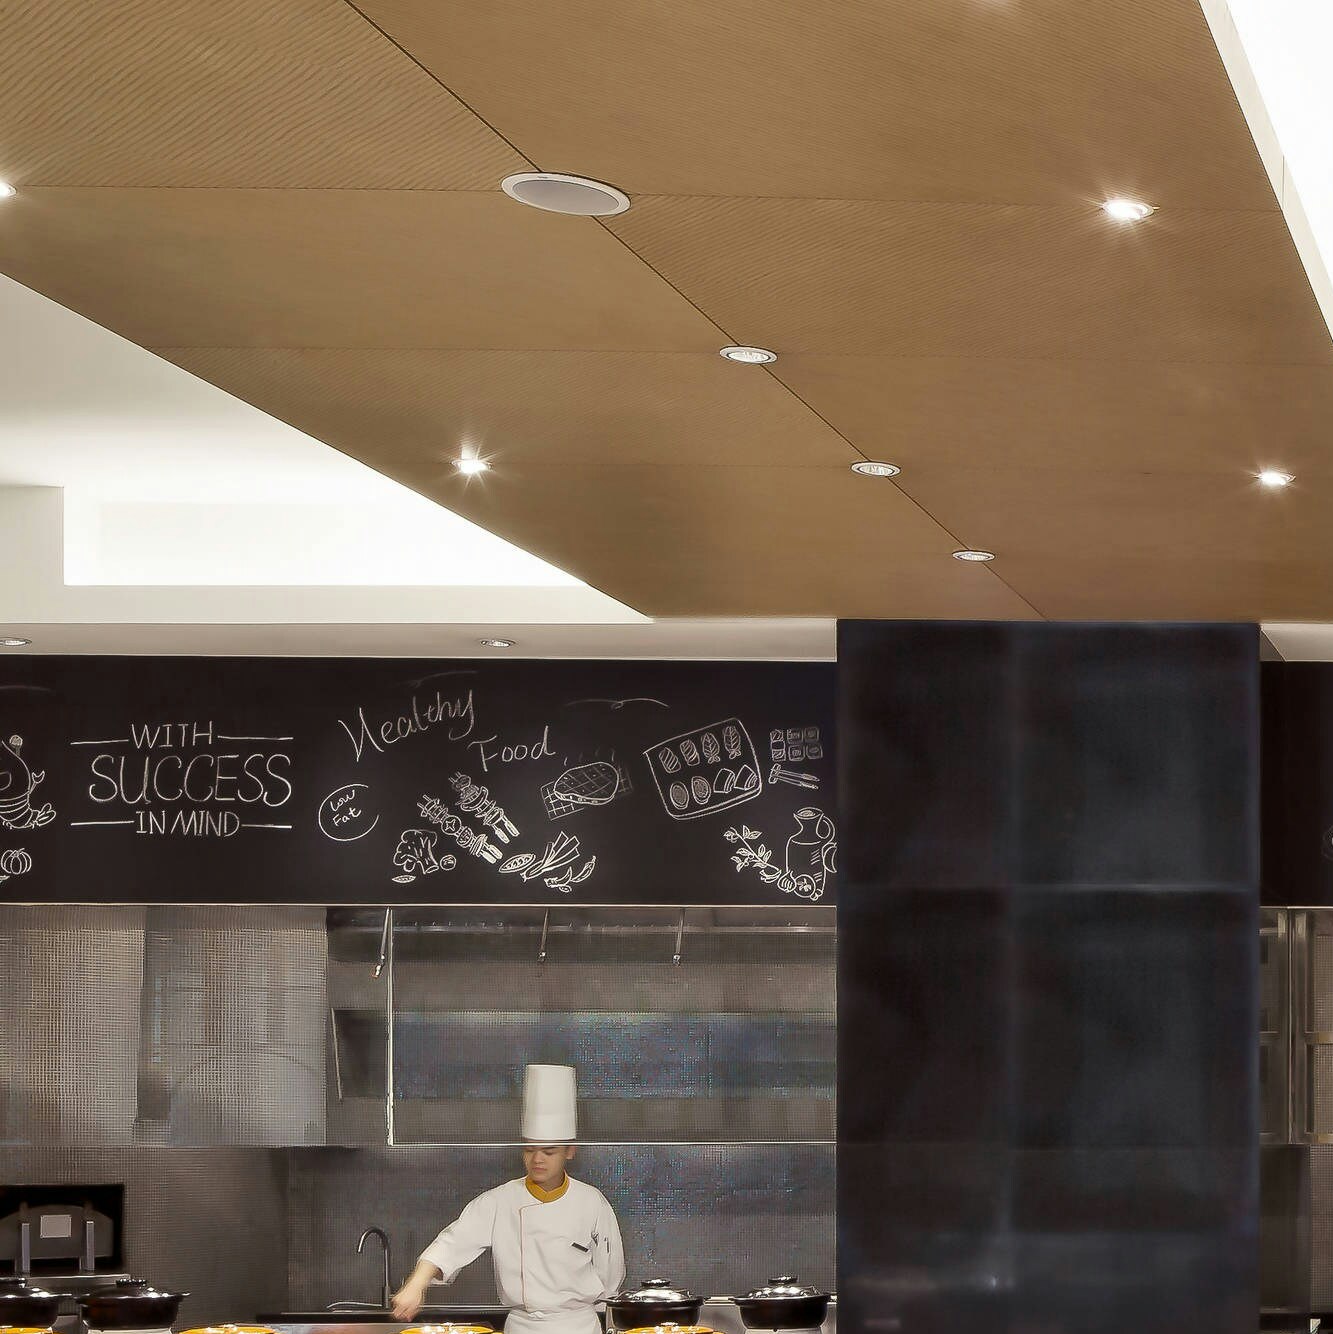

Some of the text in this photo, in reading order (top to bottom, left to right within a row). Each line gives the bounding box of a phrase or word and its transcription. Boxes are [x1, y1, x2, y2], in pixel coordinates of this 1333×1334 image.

[131, 720, 213, 749] WITH
[467, 725, 556, 772] Food
[89, 753, 292, 807] SUCCESS
[135, 810, 240, 837] IN MIND
[332, 807, 361, 827] Fat
